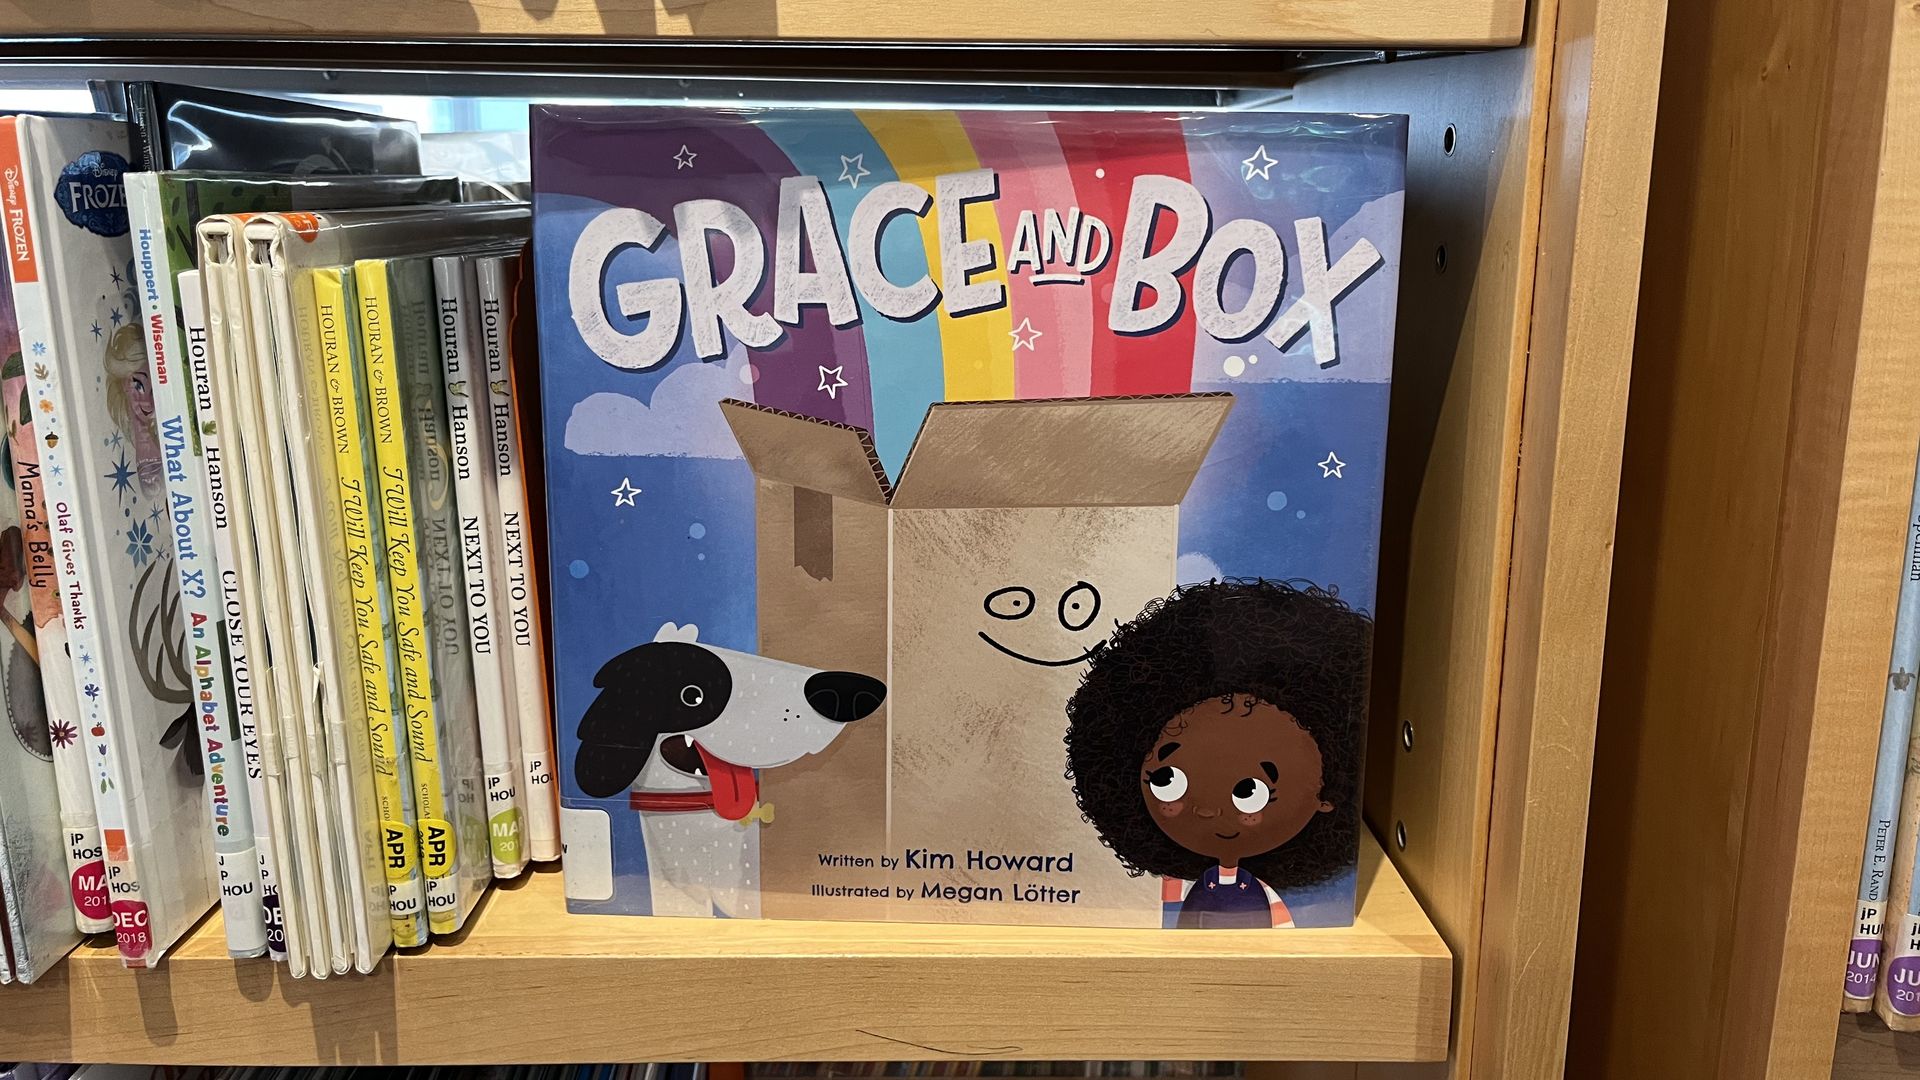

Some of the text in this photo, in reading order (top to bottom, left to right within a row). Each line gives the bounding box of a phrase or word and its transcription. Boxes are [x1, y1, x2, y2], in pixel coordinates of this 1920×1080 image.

[4, 165, 30, 261] Disney FROZEN
[69, 182, 127, 213] FROZE
[568, 168, 1386, 371] GRACE AND BOX
[139, 229, 168, 385] Houppert Wiseman
[321, 305, 349, 454] HOURAN & BROWN
[365, 297, 392, 444] HOURAN & BROWN
[483, 298, 512, 476] Houran Hanson
[441, 297, 471, 481] Houran Hanson
[189, 326, 228, 529] Houran Hanson
[161, 415, 206, 599] What About X?
[344, 495, 366, 539] Will
[385, 484, 408, 527] Will
[17, 461, 54, 588] Mama's Belly
[56, 502, 87, 630] Olaf Gives Thanks
[348, 545, 369, 589] Keep
[388, 533, 411, 577] Keep
[462, 516, 491, 654] NEXT TO YOU
[504, 511, 531, 647] NEXT TO YOU
[356, 595, 374, 629] You
[396, 584, 415, 617] You
[359, 633, 381, 674] Safe
[398, 621, 422, 662] Safe
[222, 570, 262, 779] CLOSE YOUR EYES
[405, 667, 426, 700] and
[365, 680, 386, 714] and
[191, 612, 230, 837] An Alphabet Adventure
[407, 704, 433, 763] Sound
[368, 716, 393, 777] Sound
[488, 776, 501, 789] jP
[530, 760, 541, 772] jP
[490, 786, 516, 802] HOU
[70, 833, 84, 846] jP
[386, 829, 405, 869] APR
[428, 826, 446, 866] APR
[1875, 819, 1891, 852] PETER
[73, 847, 102, 859] HOS
[818, 848, 1073, 873] Written by Kim Howard
[78, 875, 107, 891] MA
[112, 881, 140, 894] HOS
[221, 870, 228, 881] P
[223, 882, 253, 896] HOU
[811, 881, 1081, 904] Illustrated by Megan Lötter
[84, 896, 107, 907] 201
[263, 907, 284, 926] DE
[428, 893, 456, 906] HOU
[1861, 907, 1877, 920] jP
[112, 909, 148, 928] DEC
[267, 929, 284, 942] 20
[117, 931, 147, 944] 2018
[1847, 970, 1877, 984] 2014
[1894, 968, 1920, 986] JU
[1896, 989, 1920, 1002] 201
